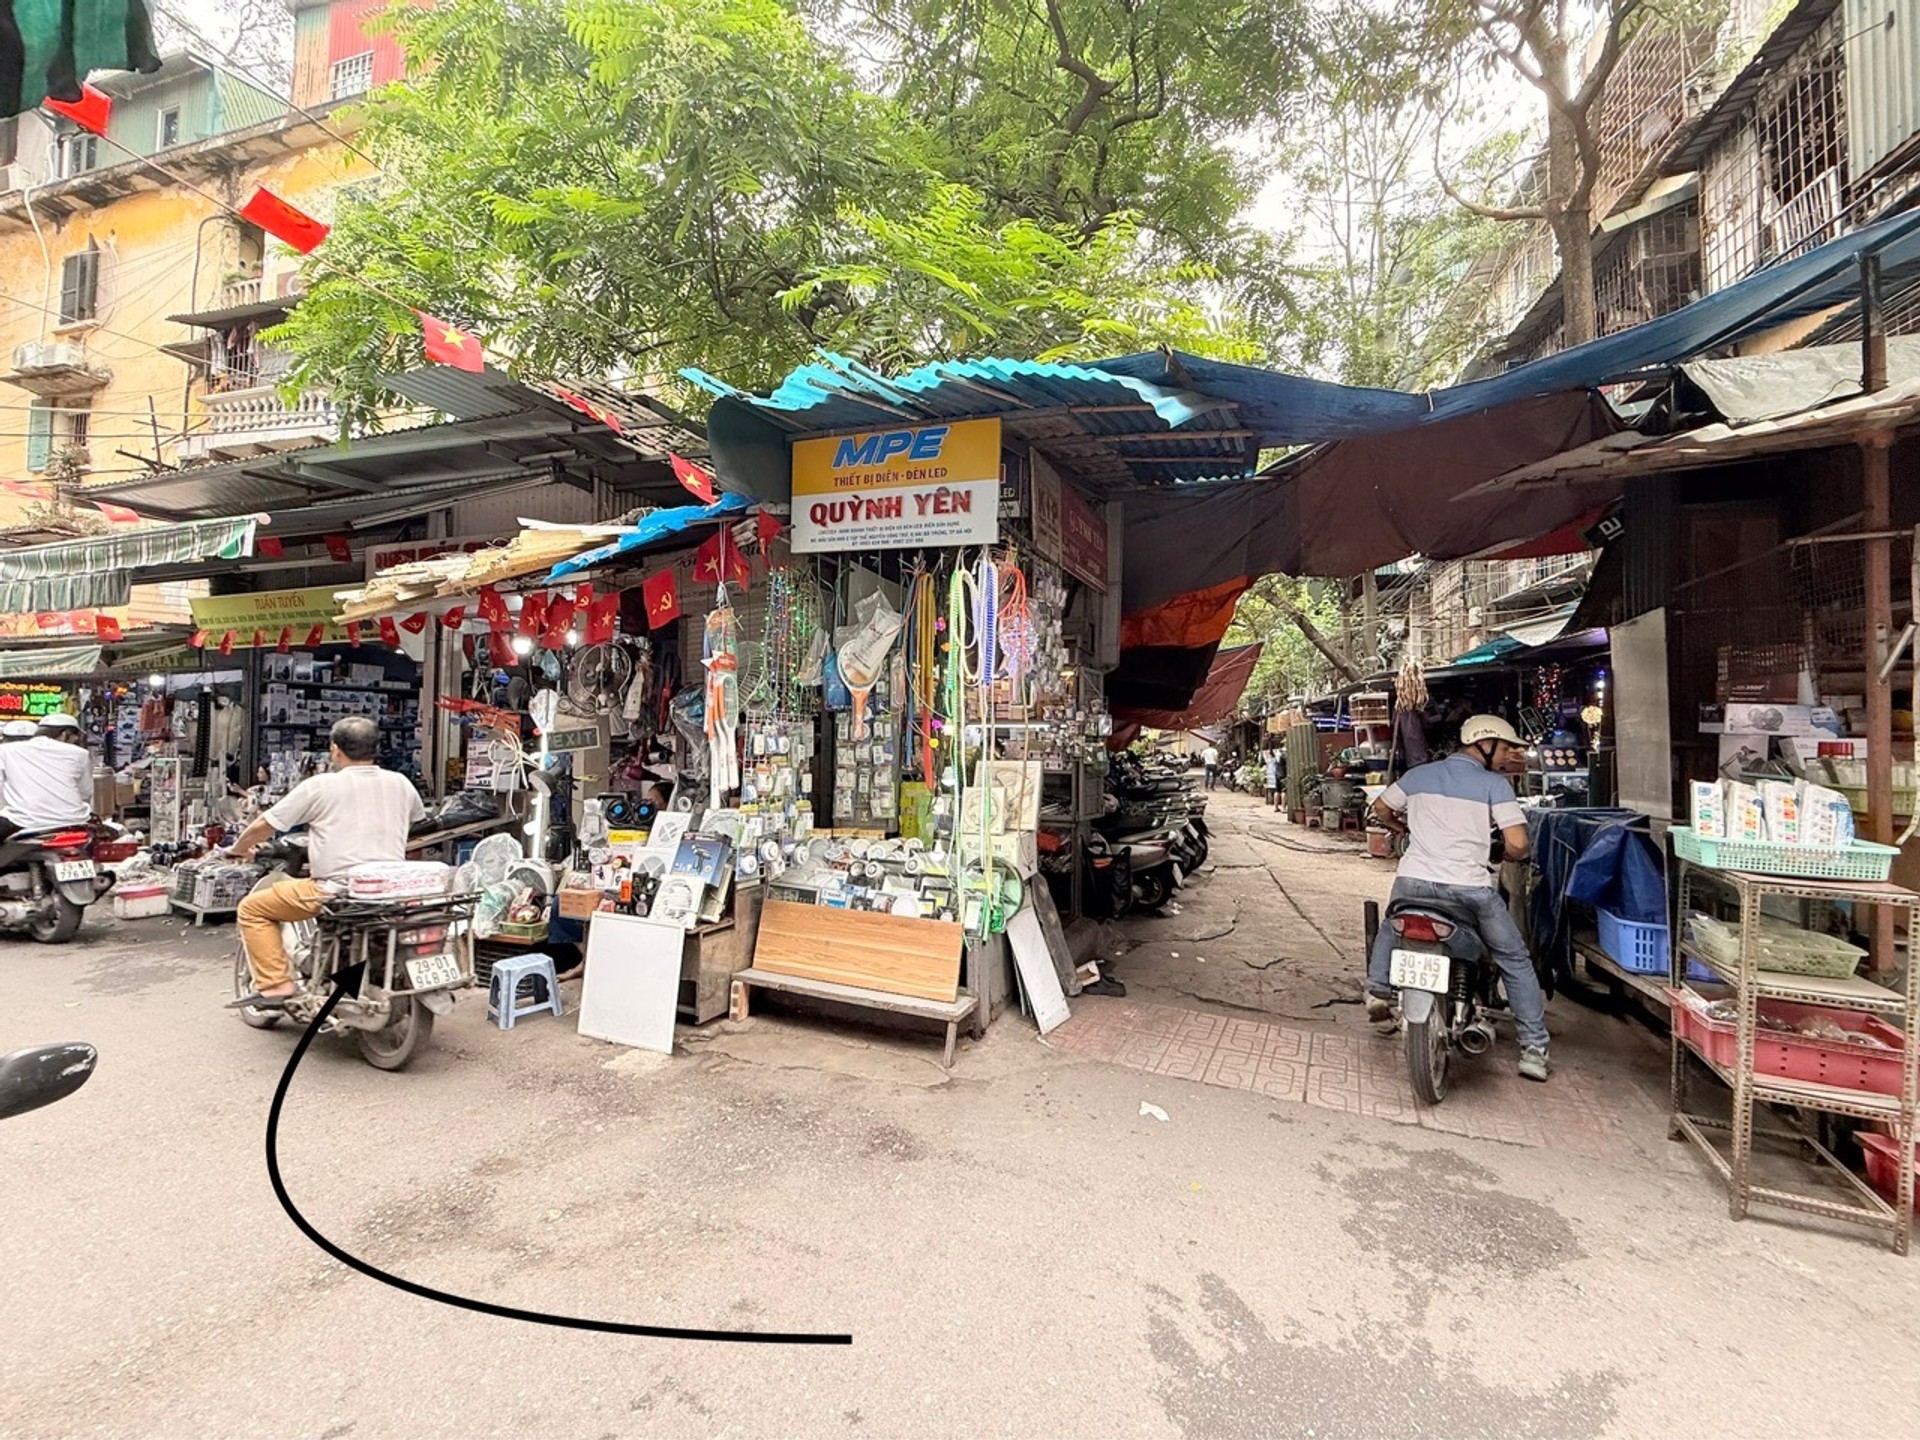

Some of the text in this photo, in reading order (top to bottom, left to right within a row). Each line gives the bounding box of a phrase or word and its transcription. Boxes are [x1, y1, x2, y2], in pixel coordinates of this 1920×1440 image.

[832, 426, 951, 470] MPE
[834, 471, 860, 487] THIẾT
[928, 467, 948, 478] LED
[809, 486, 973, 528] QUỲNH YÊN
[553, 731, 592, 748] EXIT
[415, 956, 449, 974] 29-01
[1398, 969, 1439, 988] 3367
